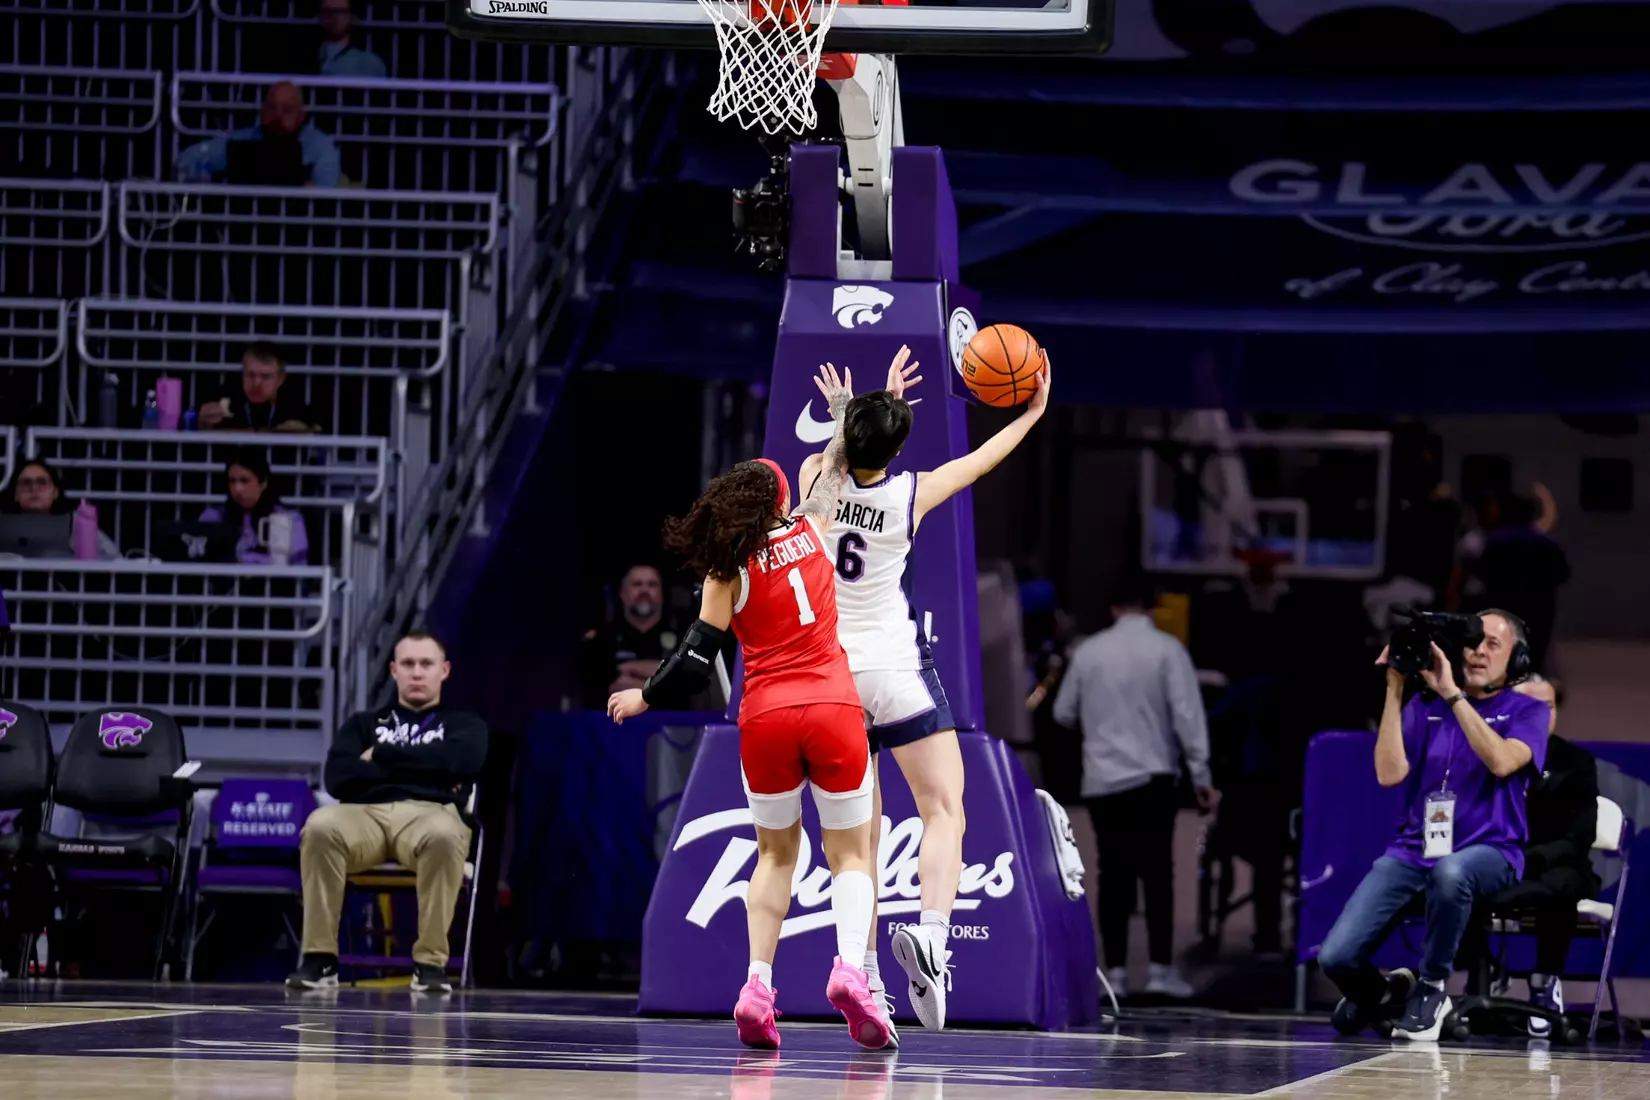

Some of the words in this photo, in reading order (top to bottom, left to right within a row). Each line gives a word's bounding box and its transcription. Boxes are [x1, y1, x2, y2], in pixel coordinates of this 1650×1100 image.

[488, 0, 549, 15] SPALDING
[757, 531, 817, 574] PEGUERO
[836, 530, 869, 583] 6
[787, 567, 817, 627] 1
[222, 820, 297, 837] RESERVED
